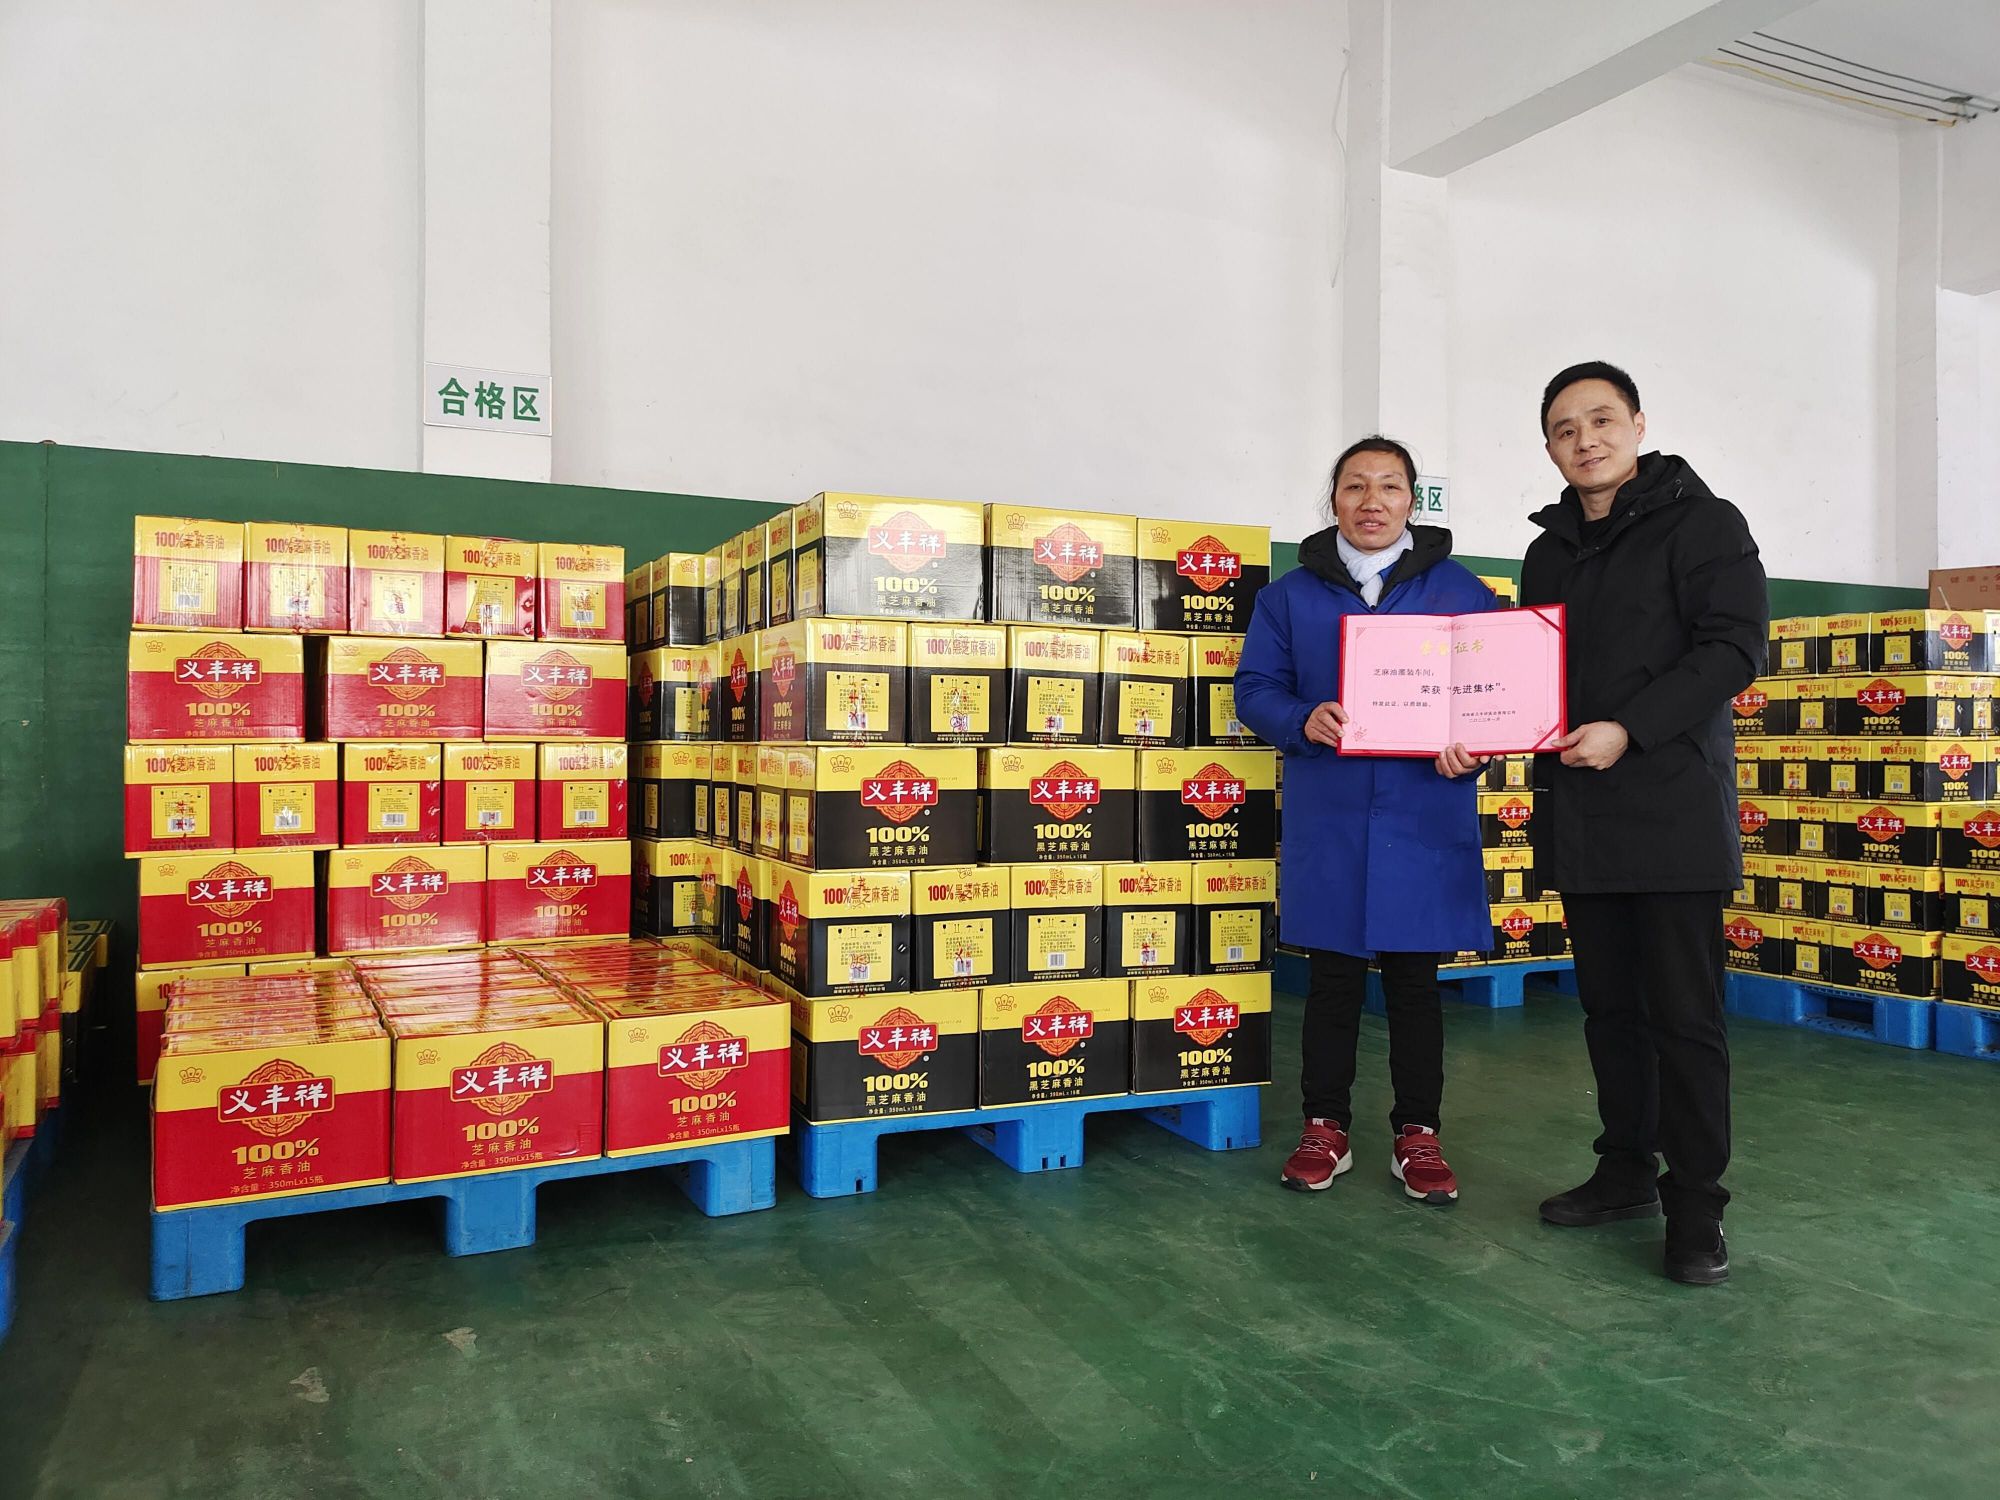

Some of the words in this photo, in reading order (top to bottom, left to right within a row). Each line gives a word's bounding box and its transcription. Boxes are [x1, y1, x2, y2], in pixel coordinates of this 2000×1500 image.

[438, 377, 540, 422] 合格区
[872, 530, 942, 554] 义丰祥
[1037, 542, 1099, 564] 义丰祥
[1179, 553, 1238, 574] 义丰祥
[874, 576, 938, 594] 100%
[1038, 584, 1096, 602] 100%
[1040, 603, 1094, 615] 黑芝麻香油
[1181, 594, 1235, 611] 100%
[1183, 611, 1233, 623] 黑芝麻香油
[1941, 625, 1971, 639] 义丰祥
[1943, 651, 1970, 660] 100%
[178, 660, 257, 682] 义丰祥
[370, 664, 442, 684] 义丰祥
[523, 665, 588, 685] 义丰祥
[731, 666, 747, 686] 义丰祥
[772, 656, 794, 678] 义丰祥
[1859, 690, 1903, 703] 义丰祥
[185, 702, 251, 716] 100%
[376, 703, 436, 717] 100%
[530, 704, 583, 717] 100%
[773, 701, 793, 718] 100%
[194, 718, 245, 728] 芝麻香油
[1861, 716, 1901, 725] 100%
[1941, 756, 1970, 768] 义丰祥
[864, 780, 934, 803] 义丰祥
[1032, 779, 1096, 801] 义丰祥
[1184, 780, 1242, 801] 义丰祥
[1942, 781, 1969, 791] 100%
[1033, 823, 1092, 839] 100%
[1185, 822, 1239, 838] 100%
[1500, 829, 1527, 838] 100%
[1859, 817, 1903, 832] 义丰祥
[866, 825, 930, 843] 100%
[869, 845, 929, 857] 黑芝麻香油
[1036, 841, 1090, 852] 黑芝麻香油
[1188, 840, 1238, 851] 黑芝麻香油
[1861, 843, 1901, 853] 100%
[373, 873, 445, 894] 义丰祥
[528, 866, 594, 887] 义丰祥
[191, 879, 269, 902] 义丰祥
[533, 903, 588, 918] 100%
[779, 897, 798, 926] 义丰祥
[197, 919, 263, 938] 100%
[379, 912, 439, 929] 100%
[205, 936, 257, 948] 芝麻香油
[1725, 926, 1761, 942] 义丰祥
[780, 942, 797, 964] 100%
[1505, 940, 1530, 949] 100%
[1856, 943, 1899, 960] 义丰祥
[1728, 949, 1760, 961] 100%
[1858, 968, 1897, 982] 100%
[1025, 1015, 1089, 1038] 义丰祥
[1176, 1007, 1236, 1028] 义丰祥
[862, 1026, 934, 1051] 义丰祥
[662, 1040, 744, 1071] 义丰祥
[1177, 1047, 1233, 1067] 100%
[1026, 1057, 1086, 1078] 100%
[1180, 1066, 1231, 1079] 黑芝麻香油
[454, 1062, 548, 1095] 义丰祥
[863, 1071, 929, 1093] 100%
[1029, 1076, 1084, 1091] 黑芝麻香油
[223, 1082, 328, 1116] 义丰祥
[667, 1090, 737, 1116] 100%
[865, 1090, 927, 1107] 黑芝麻香油
[461, 1115, 540, 1142] 100%
[676, 1111, 731, 1129] 芝麻香油
[231, 1137, 320, 1165] 100%
[471, 1137, 532, 1157] 芝麻香油
[243, 1160, 311, 1181] 芝麻香油
